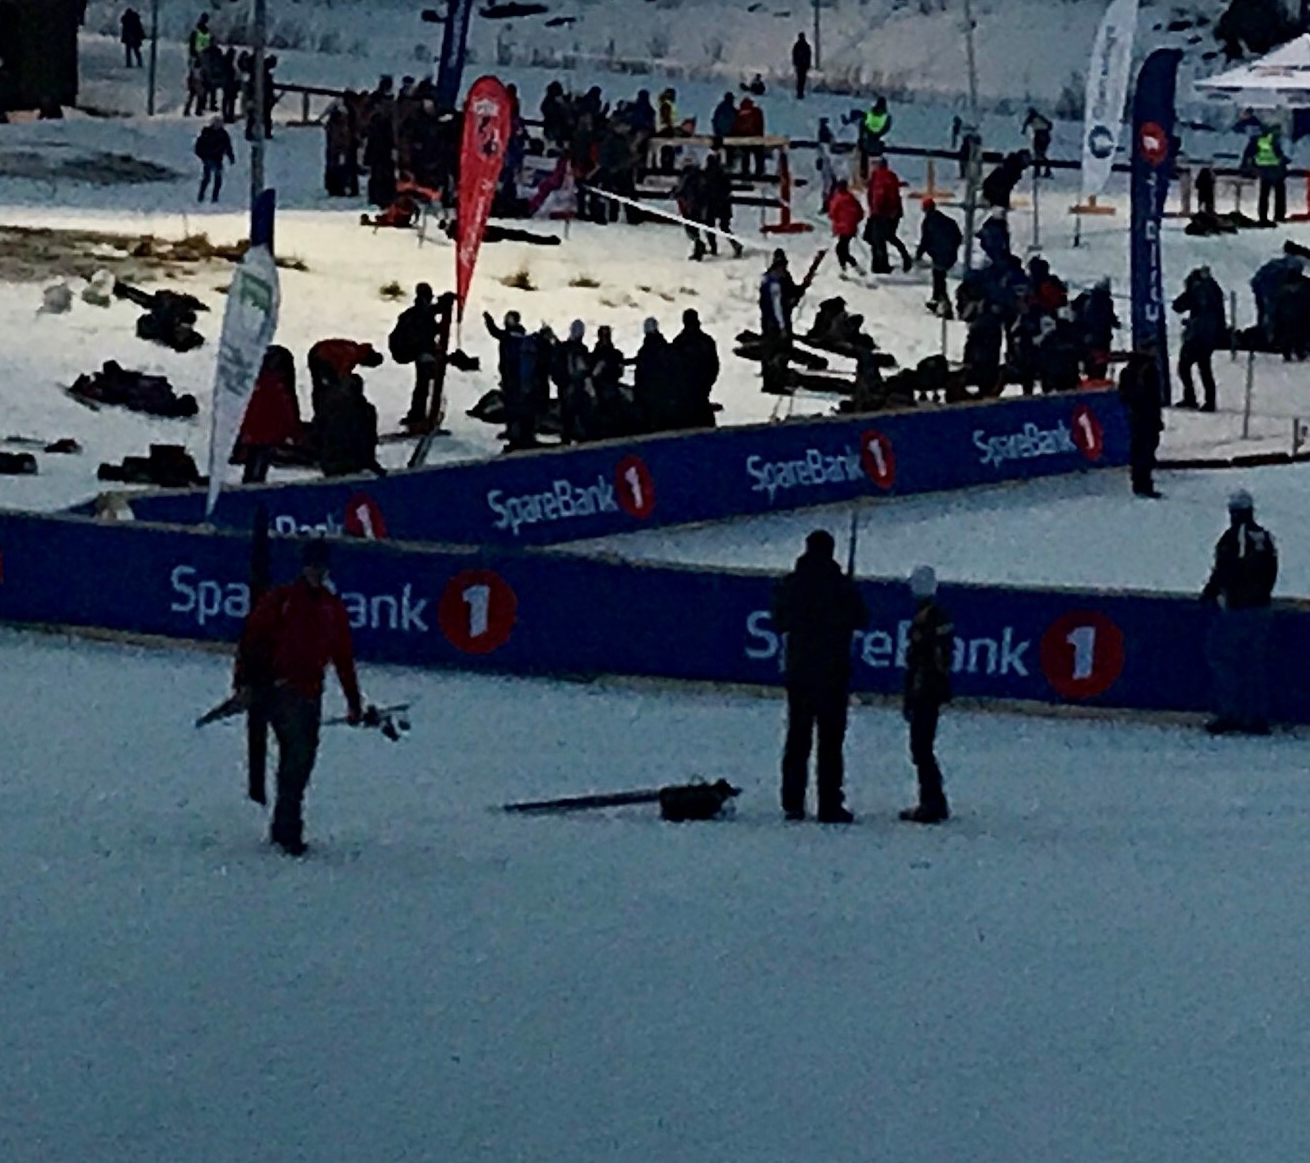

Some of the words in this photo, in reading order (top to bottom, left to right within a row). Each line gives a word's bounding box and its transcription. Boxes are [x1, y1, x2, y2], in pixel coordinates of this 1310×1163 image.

[746, 444, 865, 505] SpareBank
[867, 438, 887, 477] 1
[972, 419, 1077, 468] SpareBank
[486, 474, 620, 536] SpareBank
[624, 465, 644, 509] 1
[170, 564, 429, 632] Spaank
[462, 584, 491, 638] 1
[1065, 625, 1097, 681] 1
